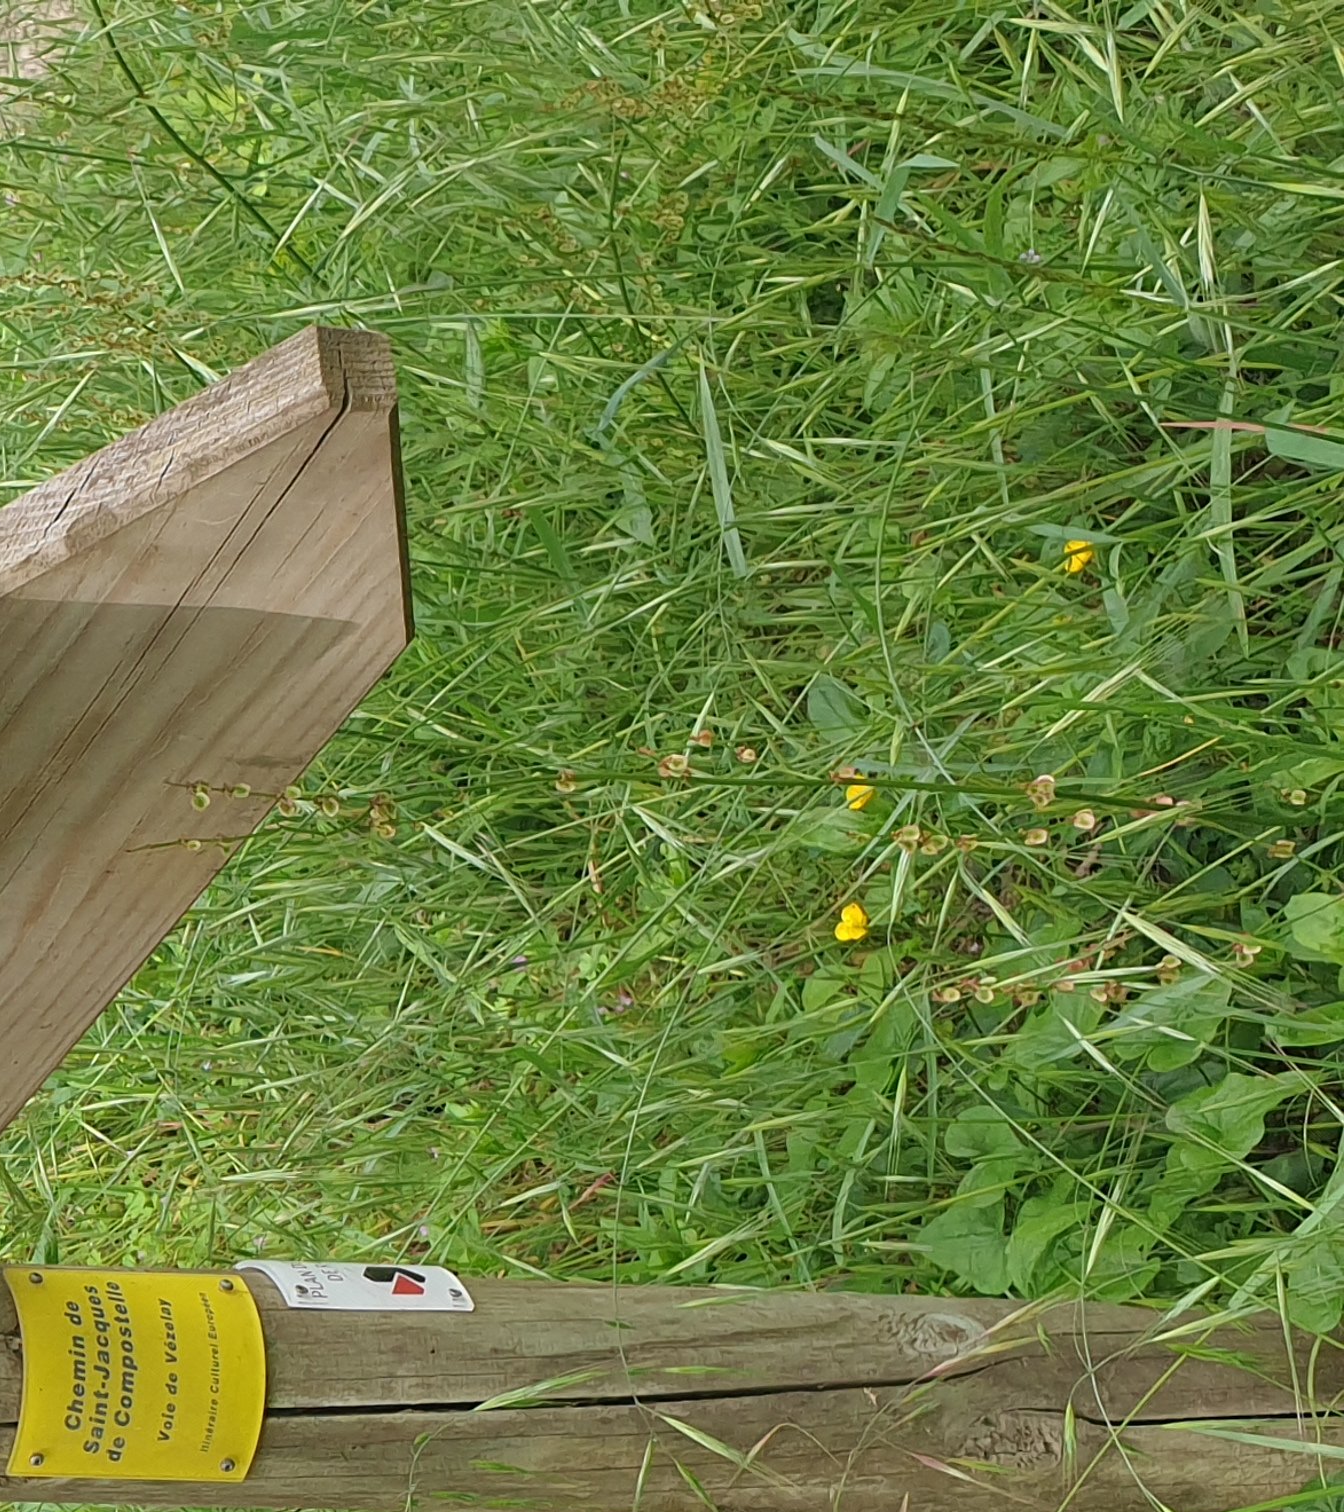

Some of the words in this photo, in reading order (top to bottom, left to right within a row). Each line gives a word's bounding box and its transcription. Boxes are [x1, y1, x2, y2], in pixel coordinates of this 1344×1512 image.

[300, 1270, 329, 1299] PLAN
[63, 1300, 83, 1326] de
[157, 1297, 178, 1363] Vézelay
[82, 1285, 111, 1455] Saint-Jacques
[105, 1281, 139, 1427] Compostelle
[208, 1343, 220, 1394] Culturel
[63, 1335, 87, 1431] Chemin
[165, 1372, 178, 1396] de
[157, 1402, 177, 1441] Voie
[105, 1436, 126, 1462] de
